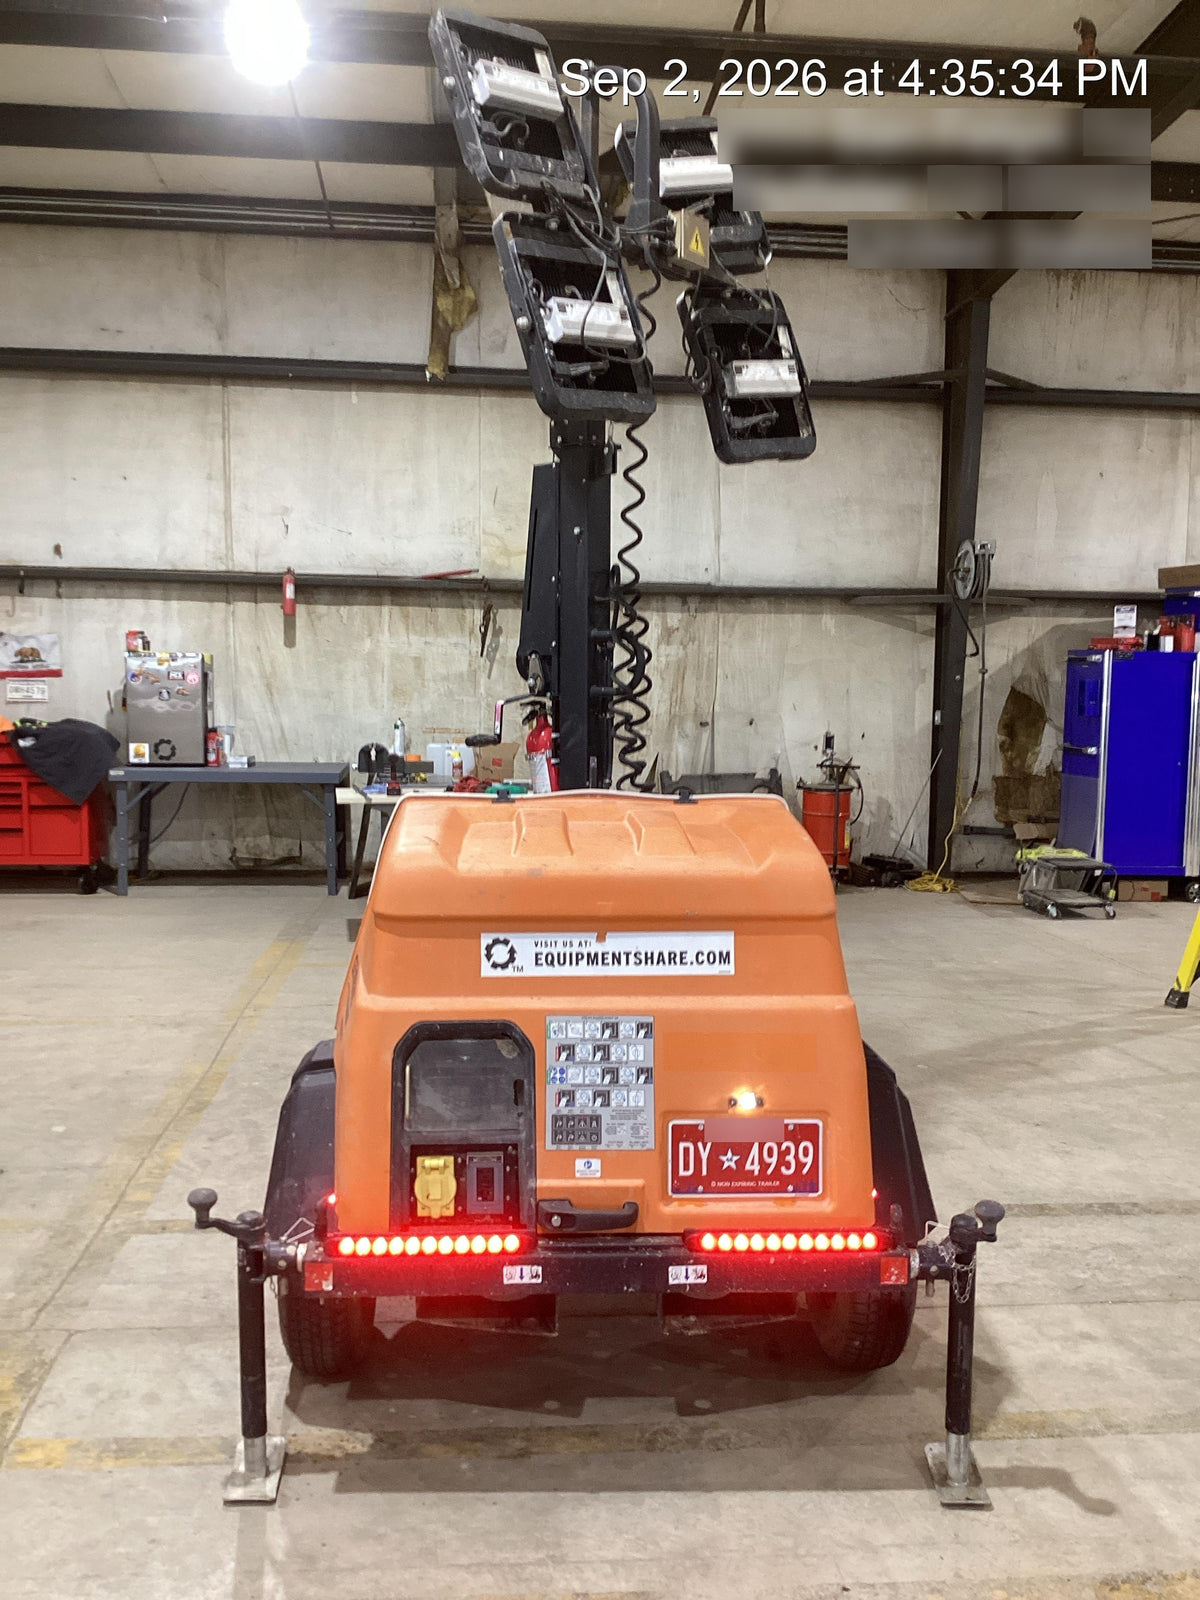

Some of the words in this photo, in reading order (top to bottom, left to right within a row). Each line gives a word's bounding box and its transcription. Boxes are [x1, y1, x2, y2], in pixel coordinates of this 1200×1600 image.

[534, 940, 558, 948] VISIT
[562, 940, 574, 948] US
[534, 950, 731, 968] EQUIPMENTSHARE.COM
[512, 965, 524, 973] TM
[678, 1141, 712, 1176] DY
[744, 1141, 814, 1176] 4939
